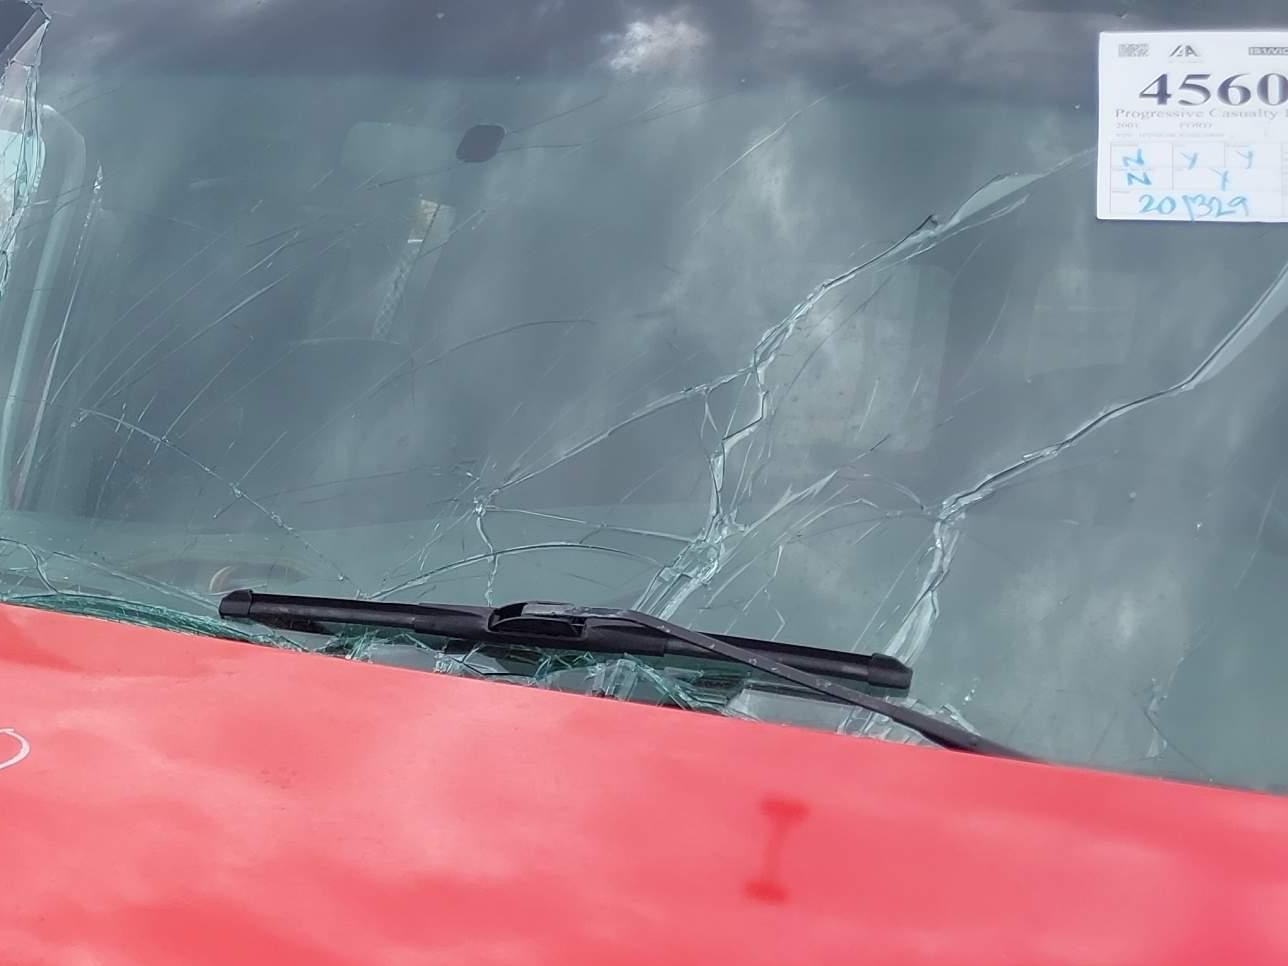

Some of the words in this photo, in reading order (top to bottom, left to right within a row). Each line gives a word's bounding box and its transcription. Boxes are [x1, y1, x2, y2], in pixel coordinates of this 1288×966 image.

[1140, 73, 1288, 106] 4560
[1115, 108, 1205, 120] Progressive
[1209, 108, 1278, 120] Casualty
